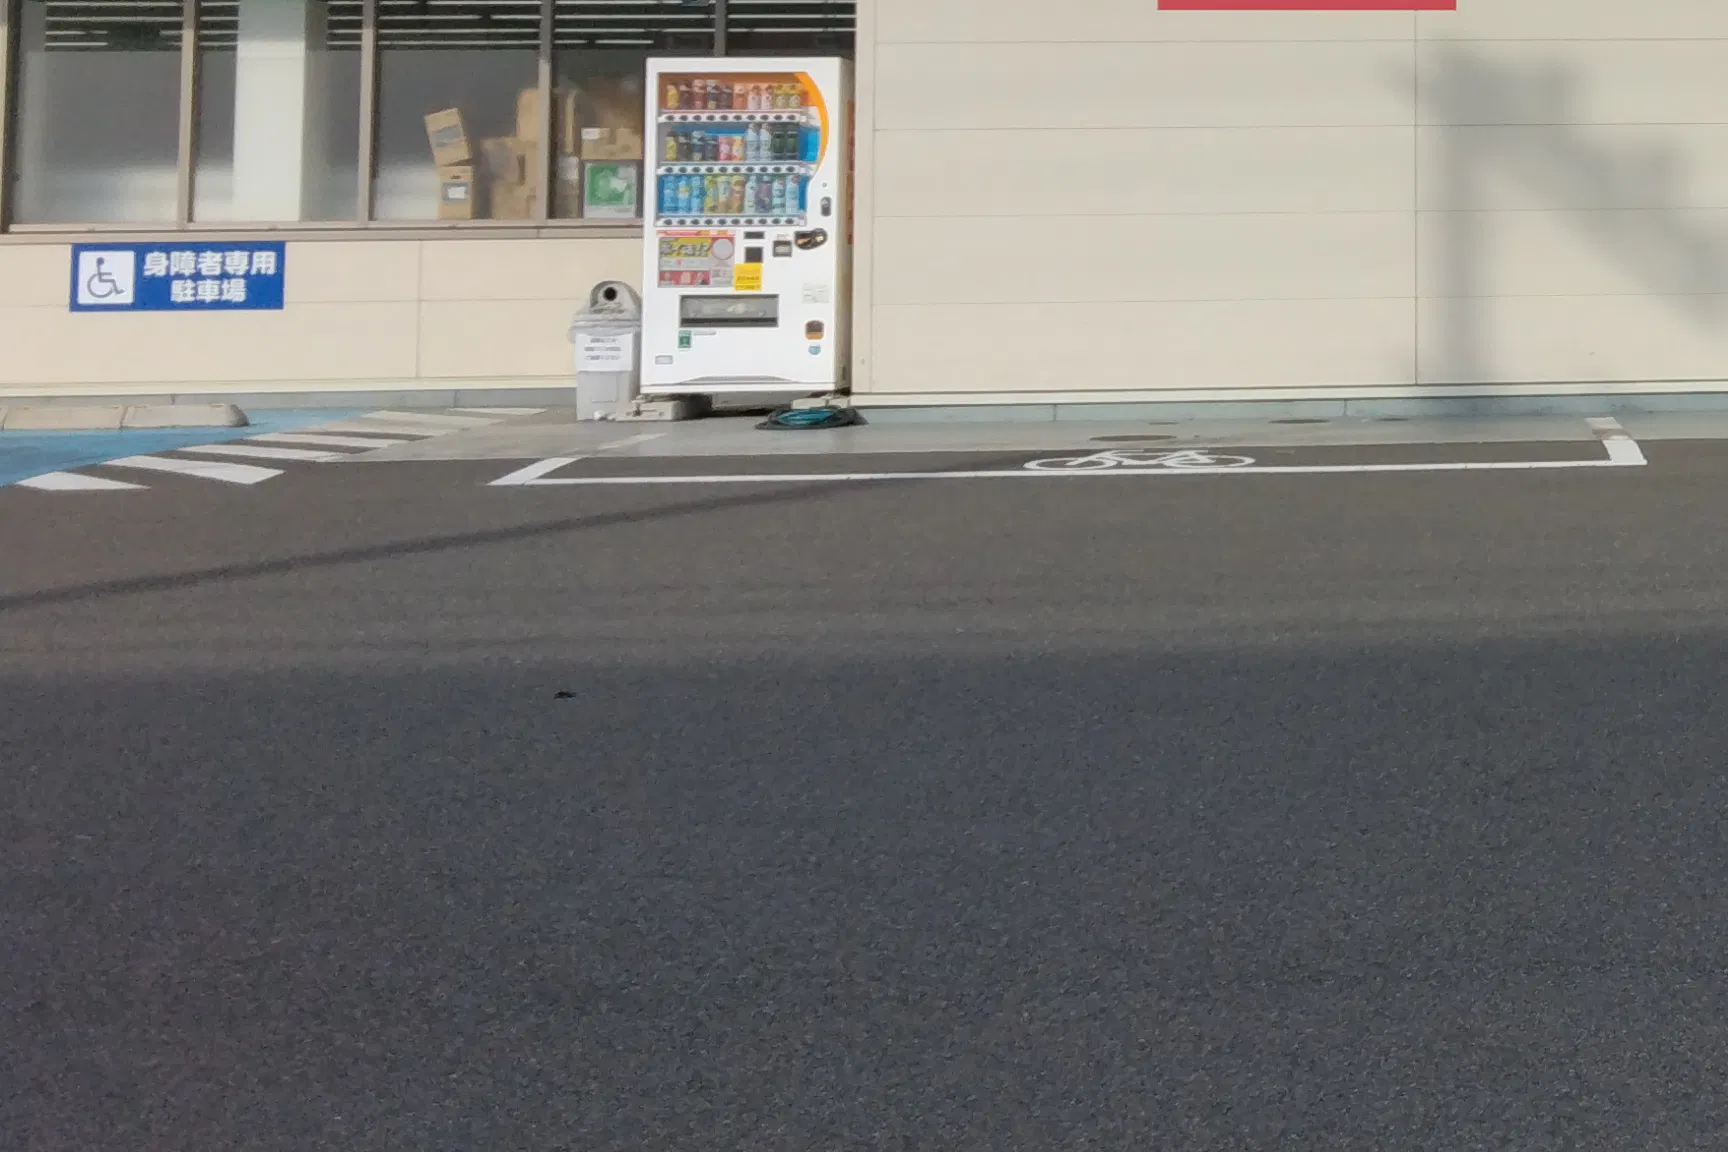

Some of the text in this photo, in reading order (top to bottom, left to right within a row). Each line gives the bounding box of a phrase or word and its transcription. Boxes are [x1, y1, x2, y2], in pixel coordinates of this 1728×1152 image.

[143, 251, 277, 277] 身障者専用
[170, 279, 247, 303] 駐車場
